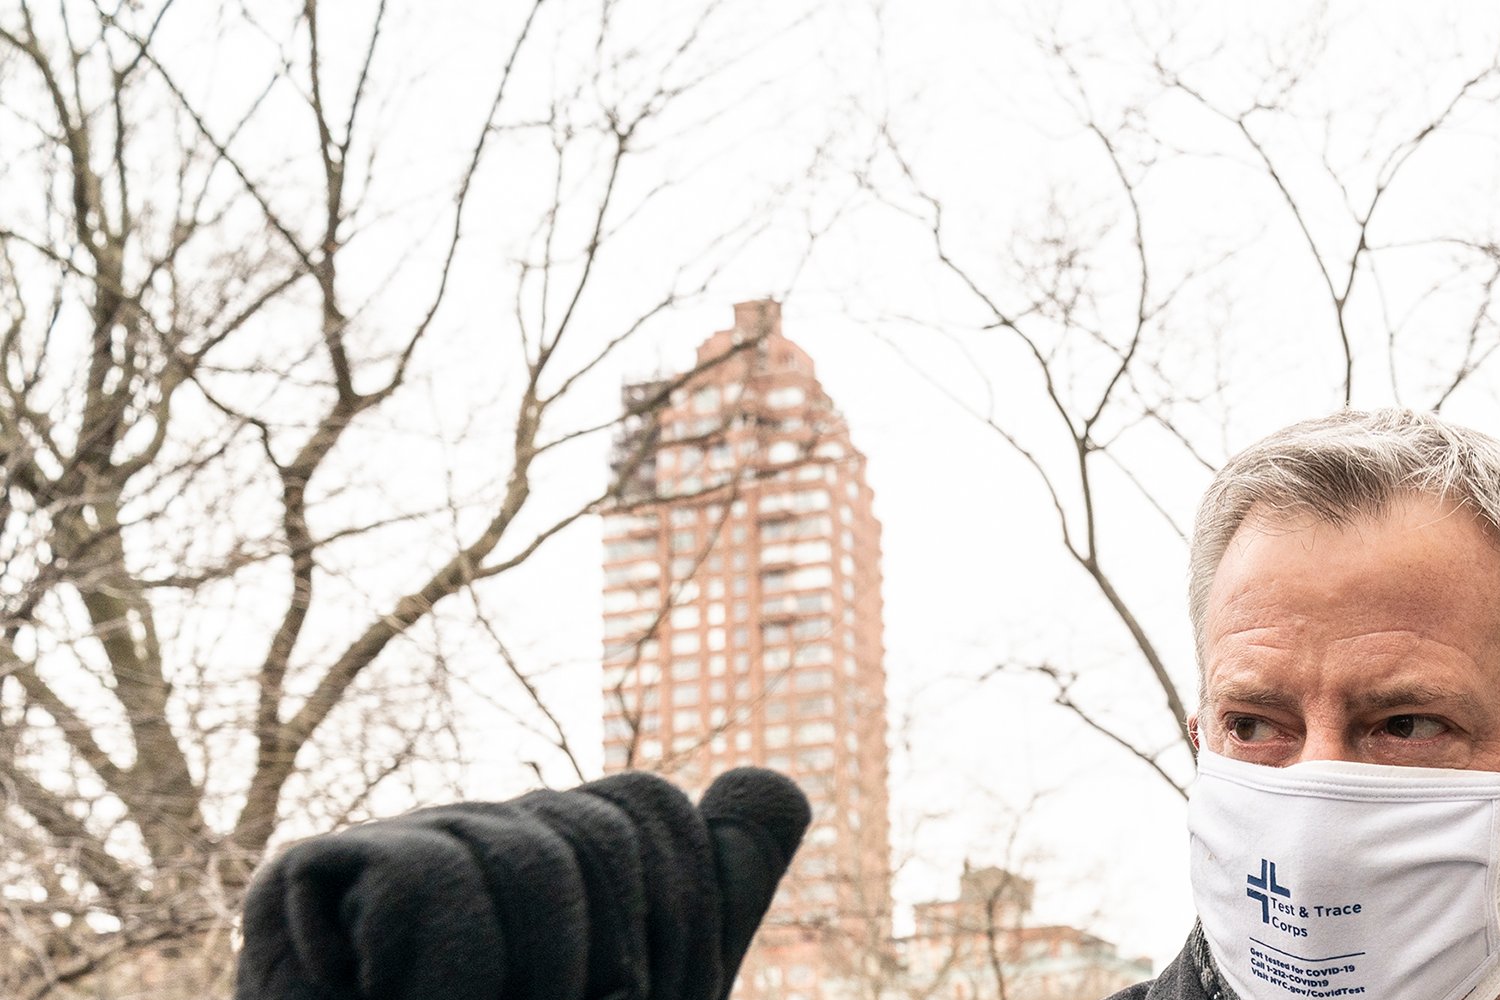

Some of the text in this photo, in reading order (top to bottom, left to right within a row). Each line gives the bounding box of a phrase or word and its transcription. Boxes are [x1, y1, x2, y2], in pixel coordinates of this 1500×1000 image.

[1271, 897, 1361, 918] Test & Trace
[1272, 916, 1308, 937] Corps
[1250, 947, 1355, 977] Get tested for COVID-19
[1251, 958, 1329, 987] Call 1-212-COVID19
[1251, 968, 1365, 998] Visit NYC.gov/CovidTest
